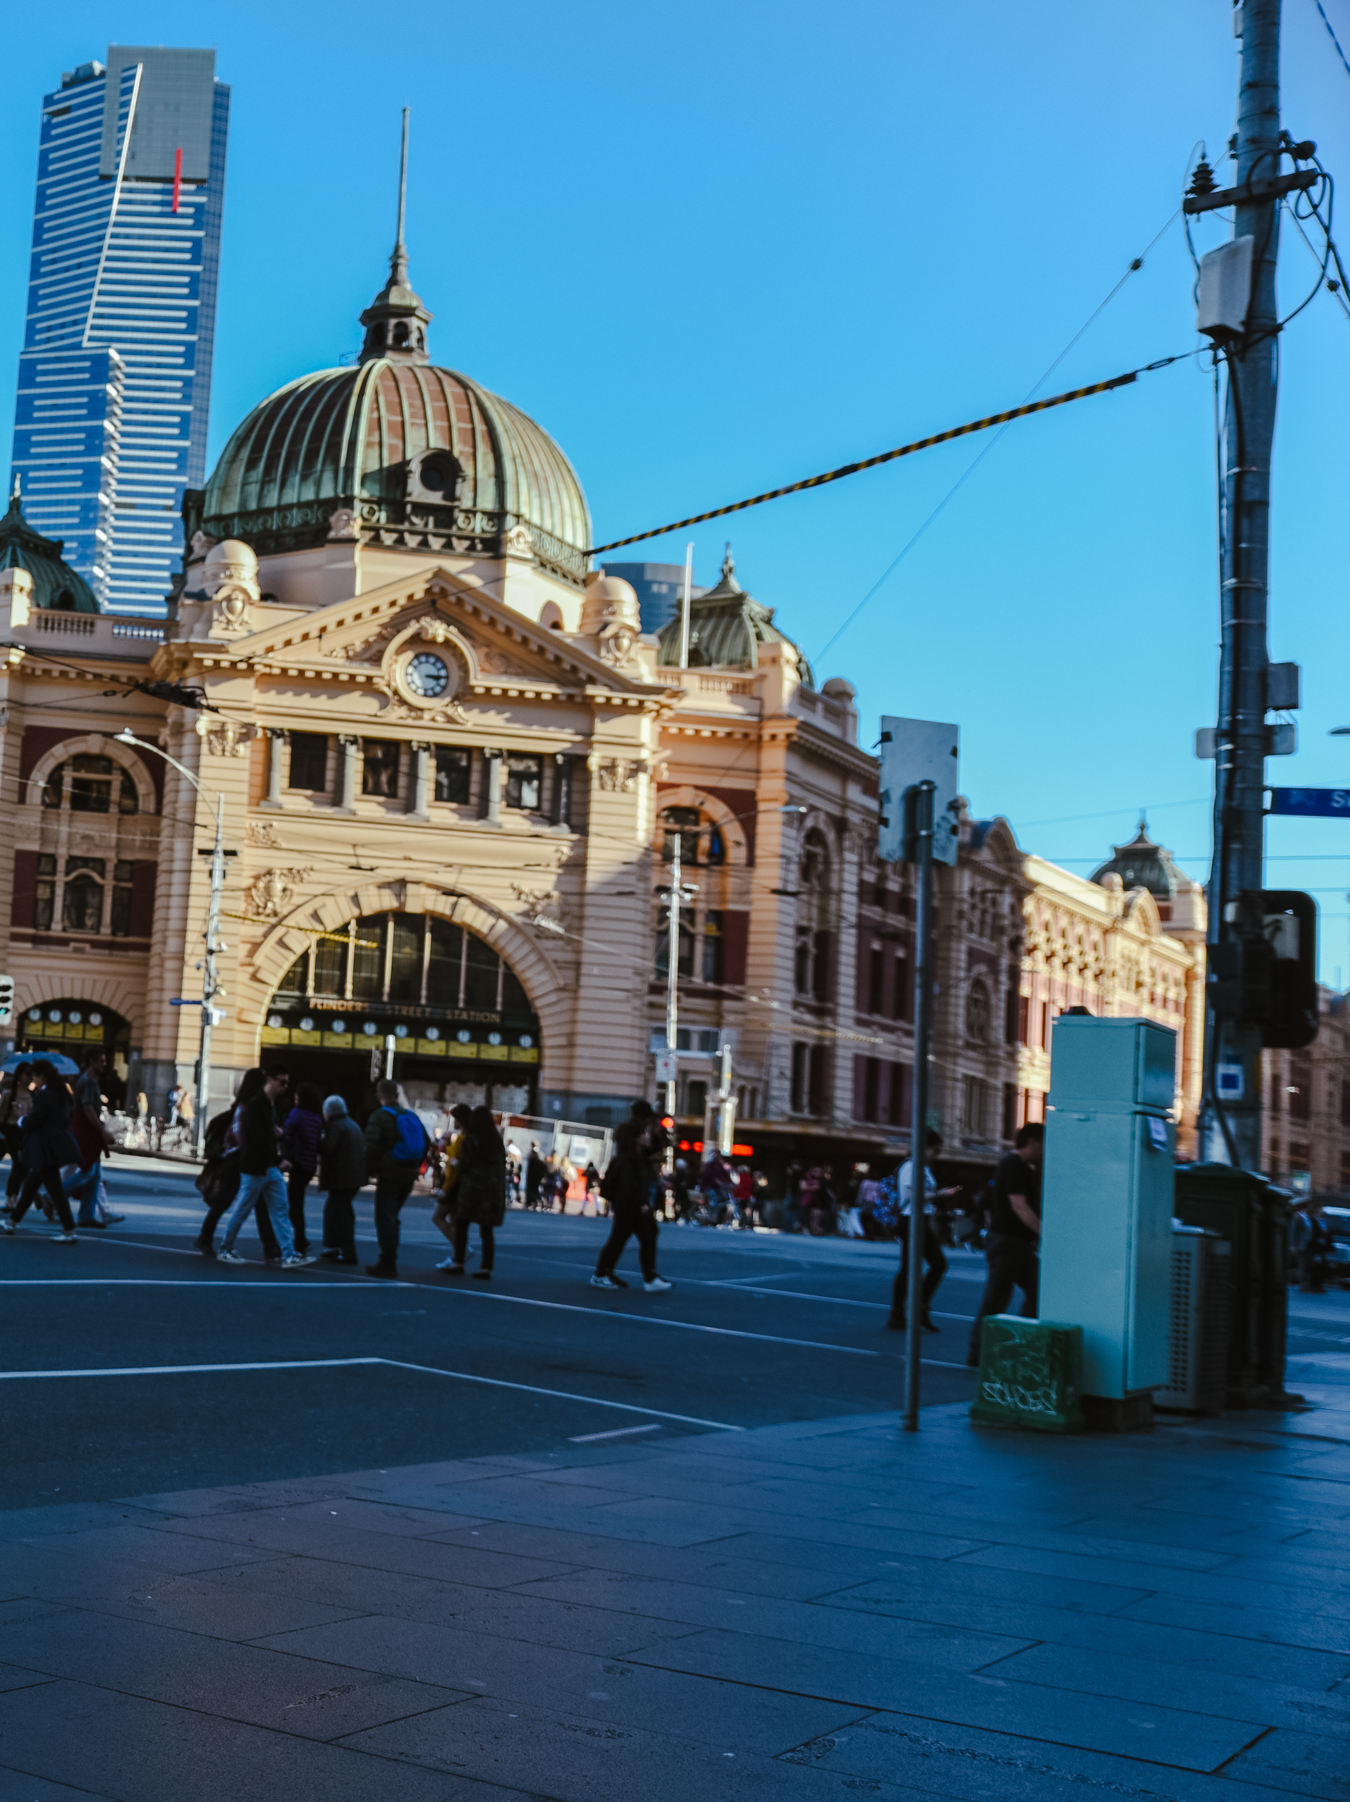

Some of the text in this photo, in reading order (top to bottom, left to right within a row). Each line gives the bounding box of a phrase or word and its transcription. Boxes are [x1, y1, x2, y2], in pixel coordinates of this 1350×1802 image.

[309, 998, 501, 1023] FLINDERS STREET STATION
